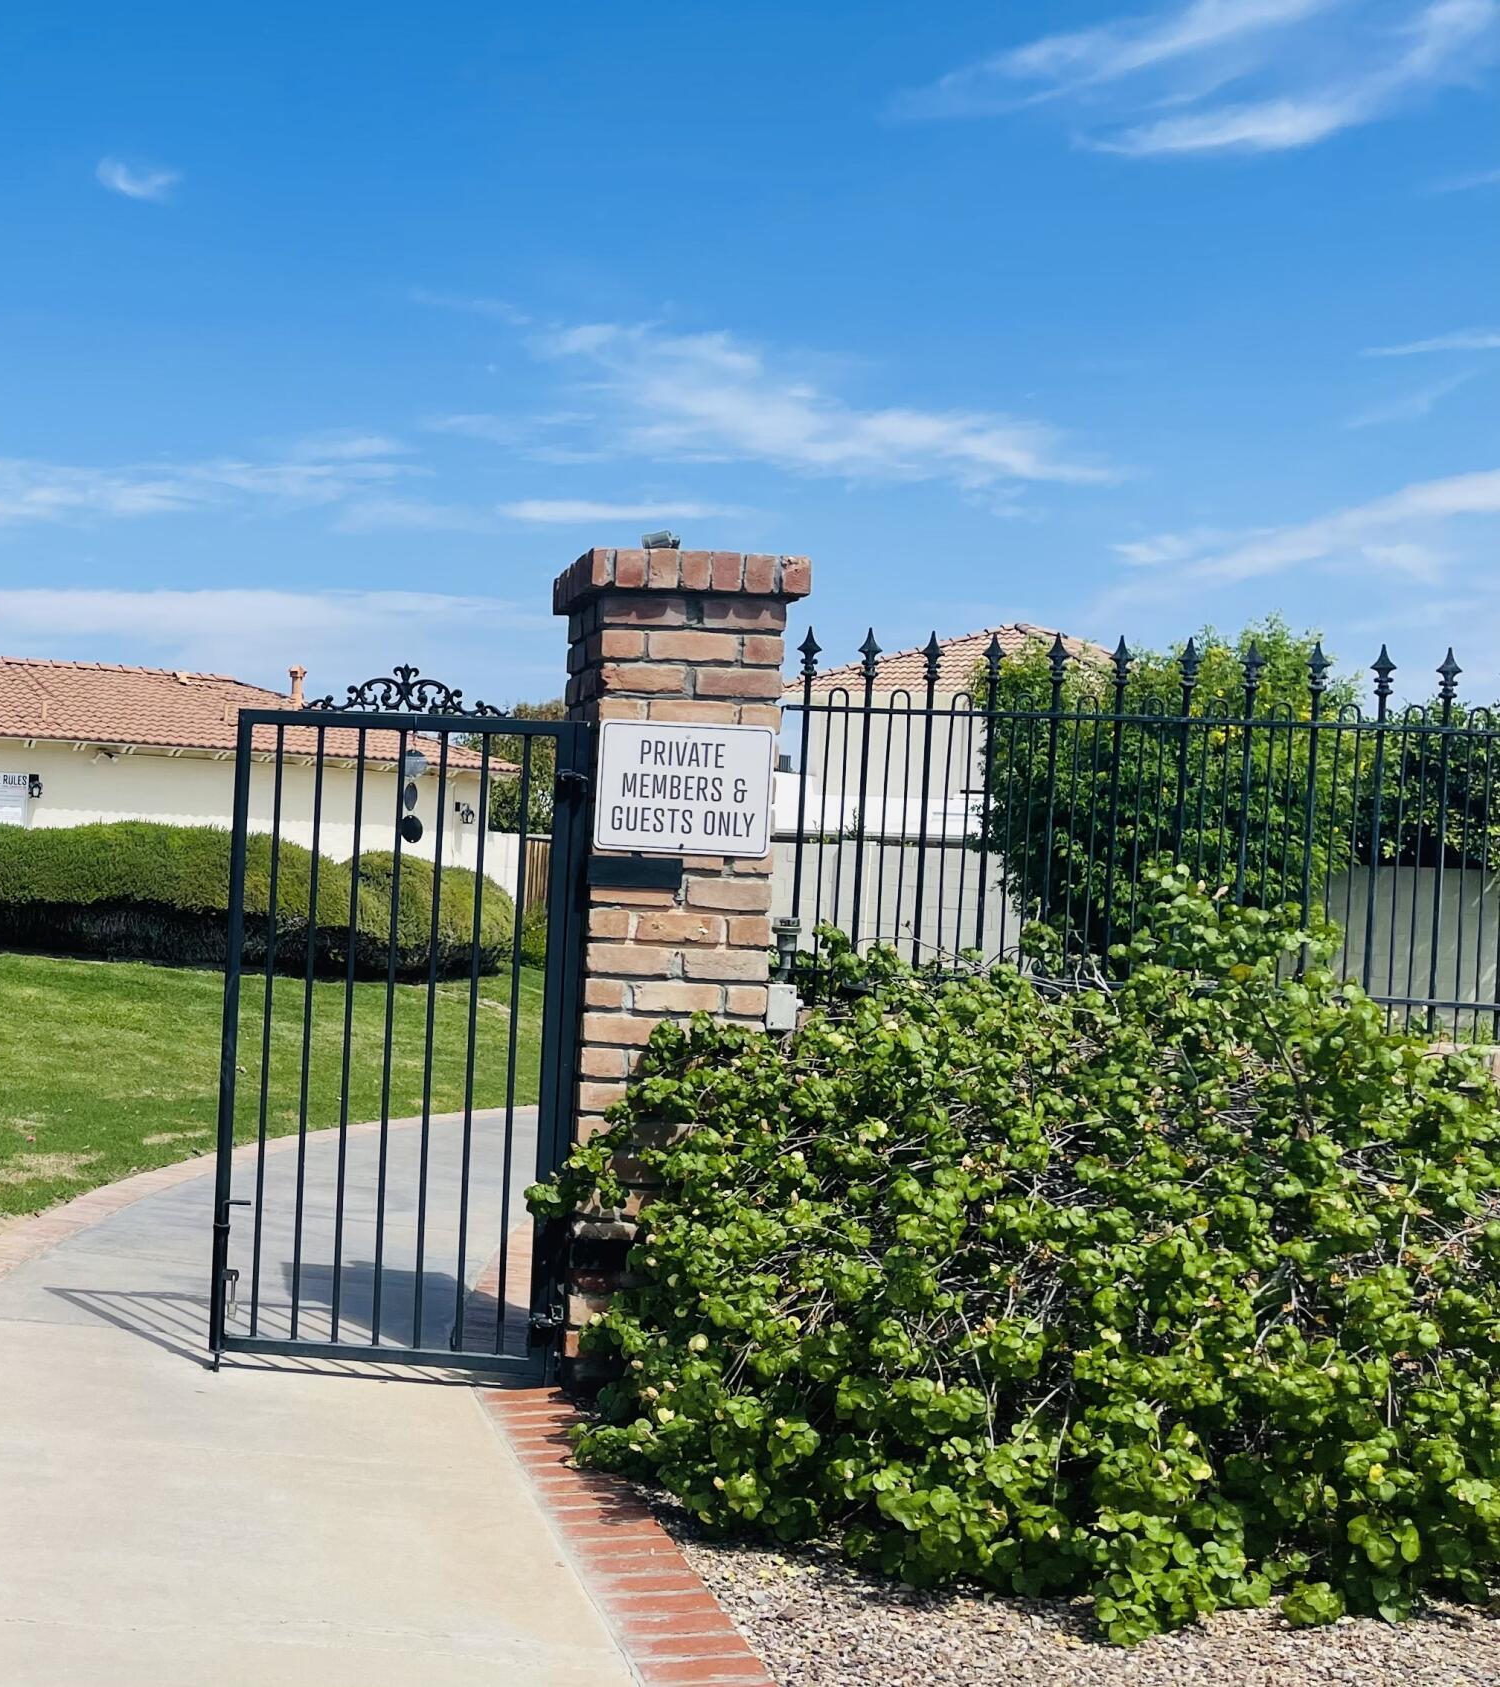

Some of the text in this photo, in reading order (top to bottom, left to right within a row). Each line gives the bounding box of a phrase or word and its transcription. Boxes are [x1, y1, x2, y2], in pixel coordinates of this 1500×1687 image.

[639, 739, 726, 769] PRIVATE
[2, 774, 27, 786] RULES
[621, 772, 748, 804] MEMBERS &
[610, 805, 756, 838] GUESTS ONLY
